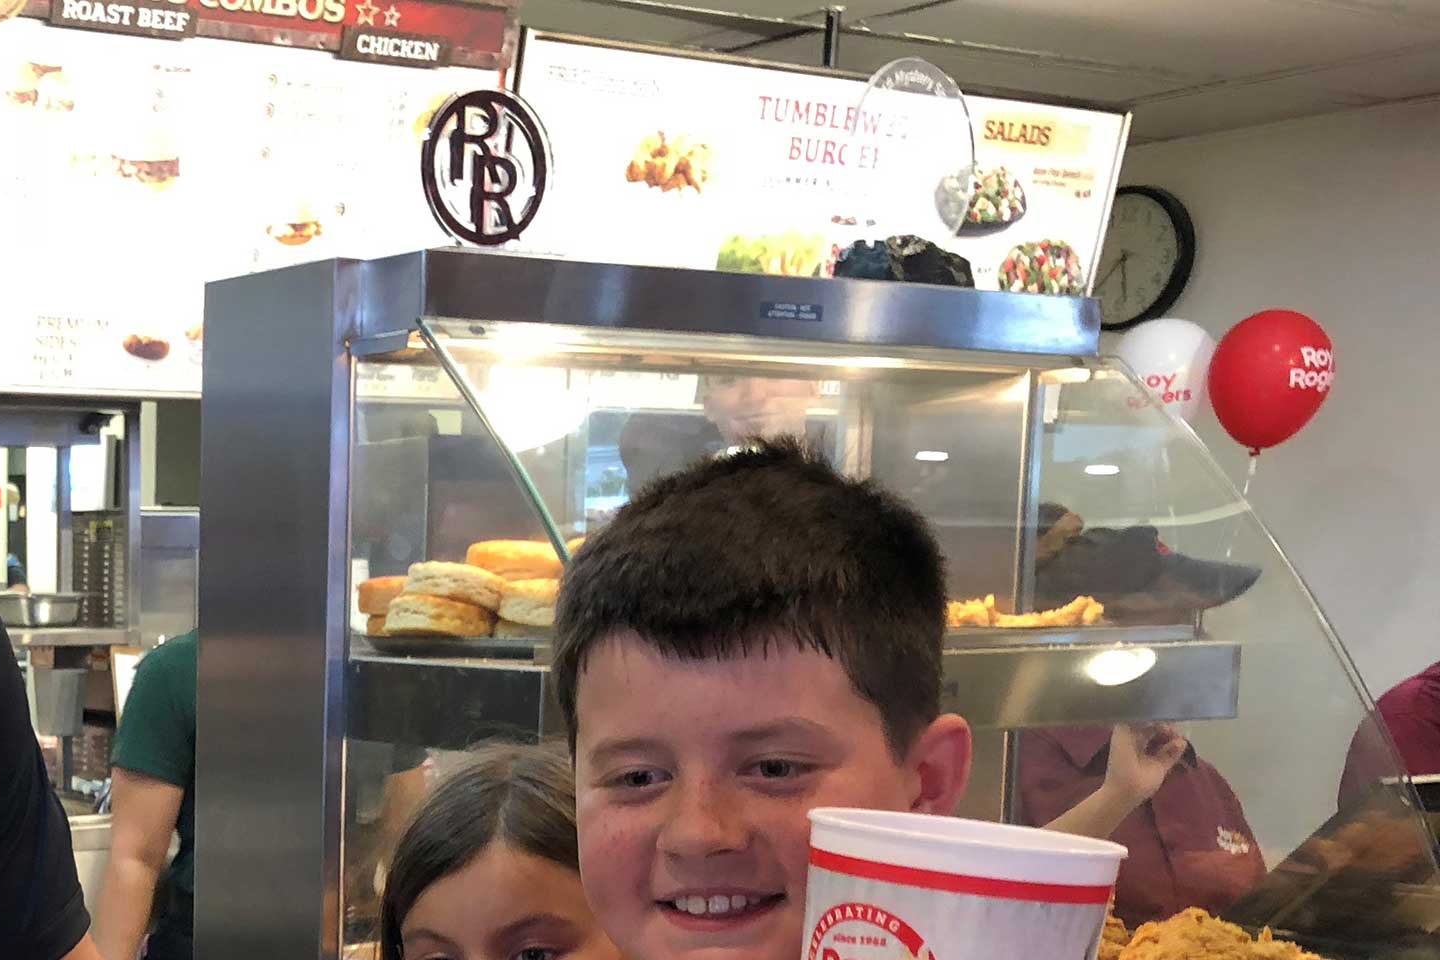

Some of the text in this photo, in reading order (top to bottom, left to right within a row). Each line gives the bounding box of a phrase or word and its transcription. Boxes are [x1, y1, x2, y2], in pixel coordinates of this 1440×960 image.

[61, 0, 190, 31] ROAST BEEF
[356, 34, 440, 61] CHICKEN
[984, 120, 1052, 146] SALADS
[810, 905, 901, 960] CELEBRATING
